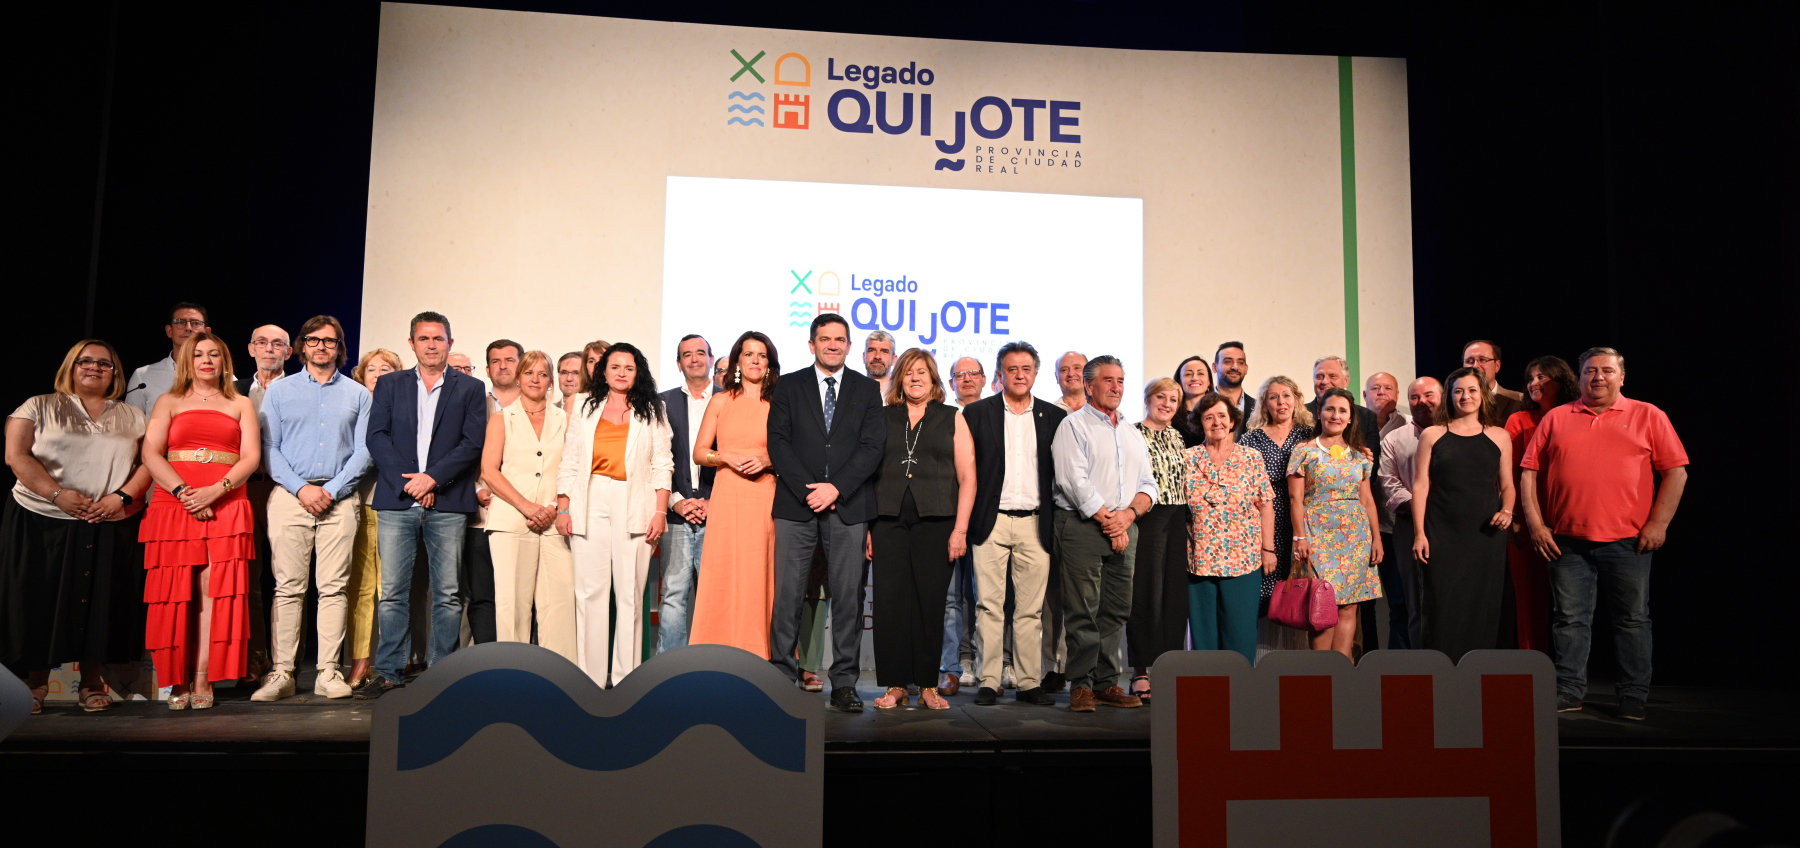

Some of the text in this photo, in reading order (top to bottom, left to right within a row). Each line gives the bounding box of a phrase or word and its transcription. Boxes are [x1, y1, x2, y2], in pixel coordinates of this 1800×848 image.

[827, 57, 935, 89] Legado
[975, 145, 1082, 159] PROVINCIA
[975, 155, 1082, 168] DE CIUDAD
[975, 164, 1019, 175] REAL
[851, 273, 918, 297] Legado
[943, 345, 1001, 354] DE CIUD
